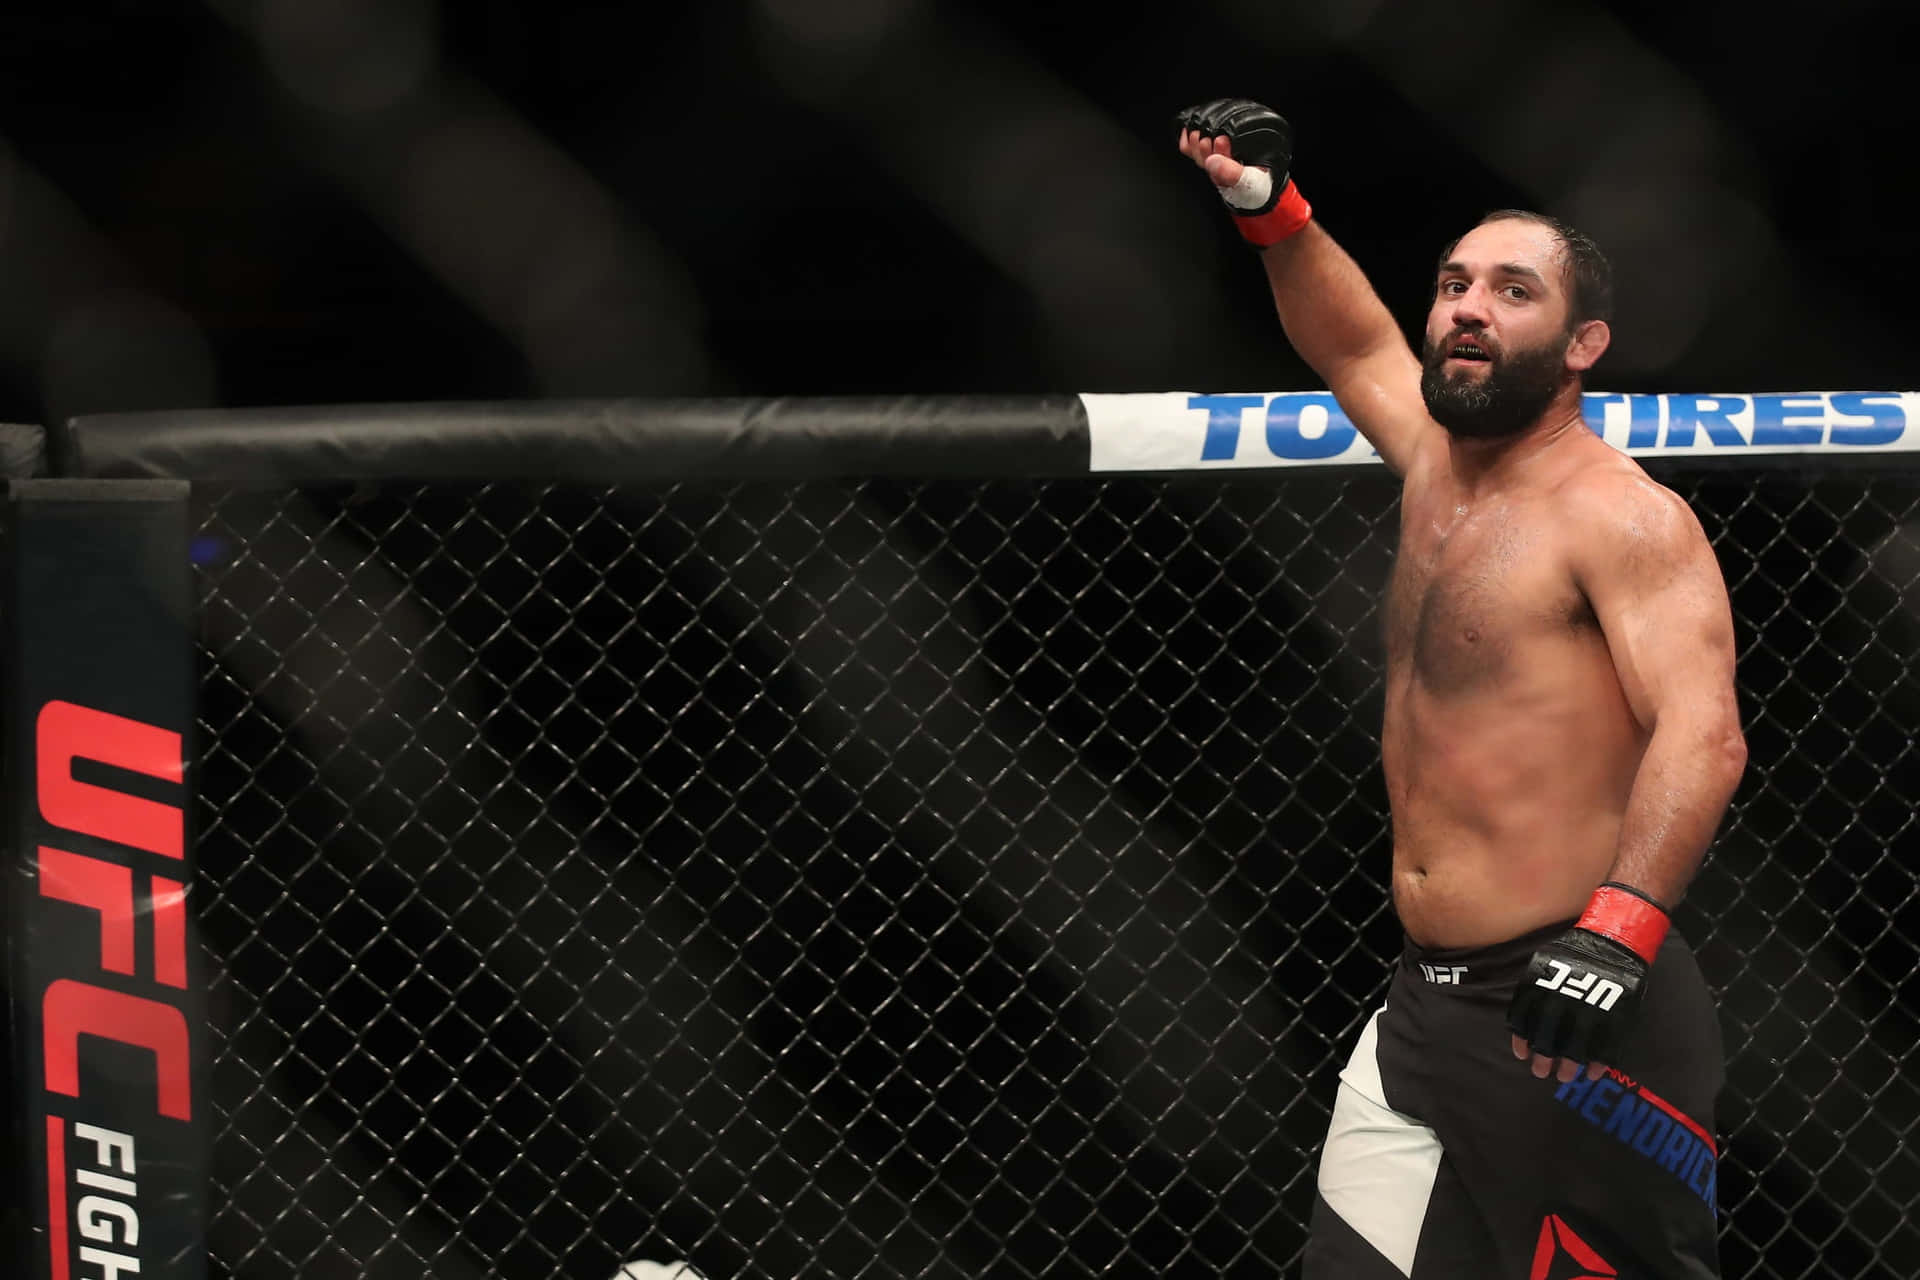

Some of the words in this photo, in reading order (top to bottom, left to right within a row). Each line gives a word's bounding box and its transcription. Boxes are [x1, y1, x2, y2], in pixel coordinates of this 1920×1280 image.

[1187, 394, 1381, 461] TO
[1580, 392, 1906, 448] TIRES
[36, 699, 191, 1121] UFC
[1535, 959, 1624, 1012] UFC
